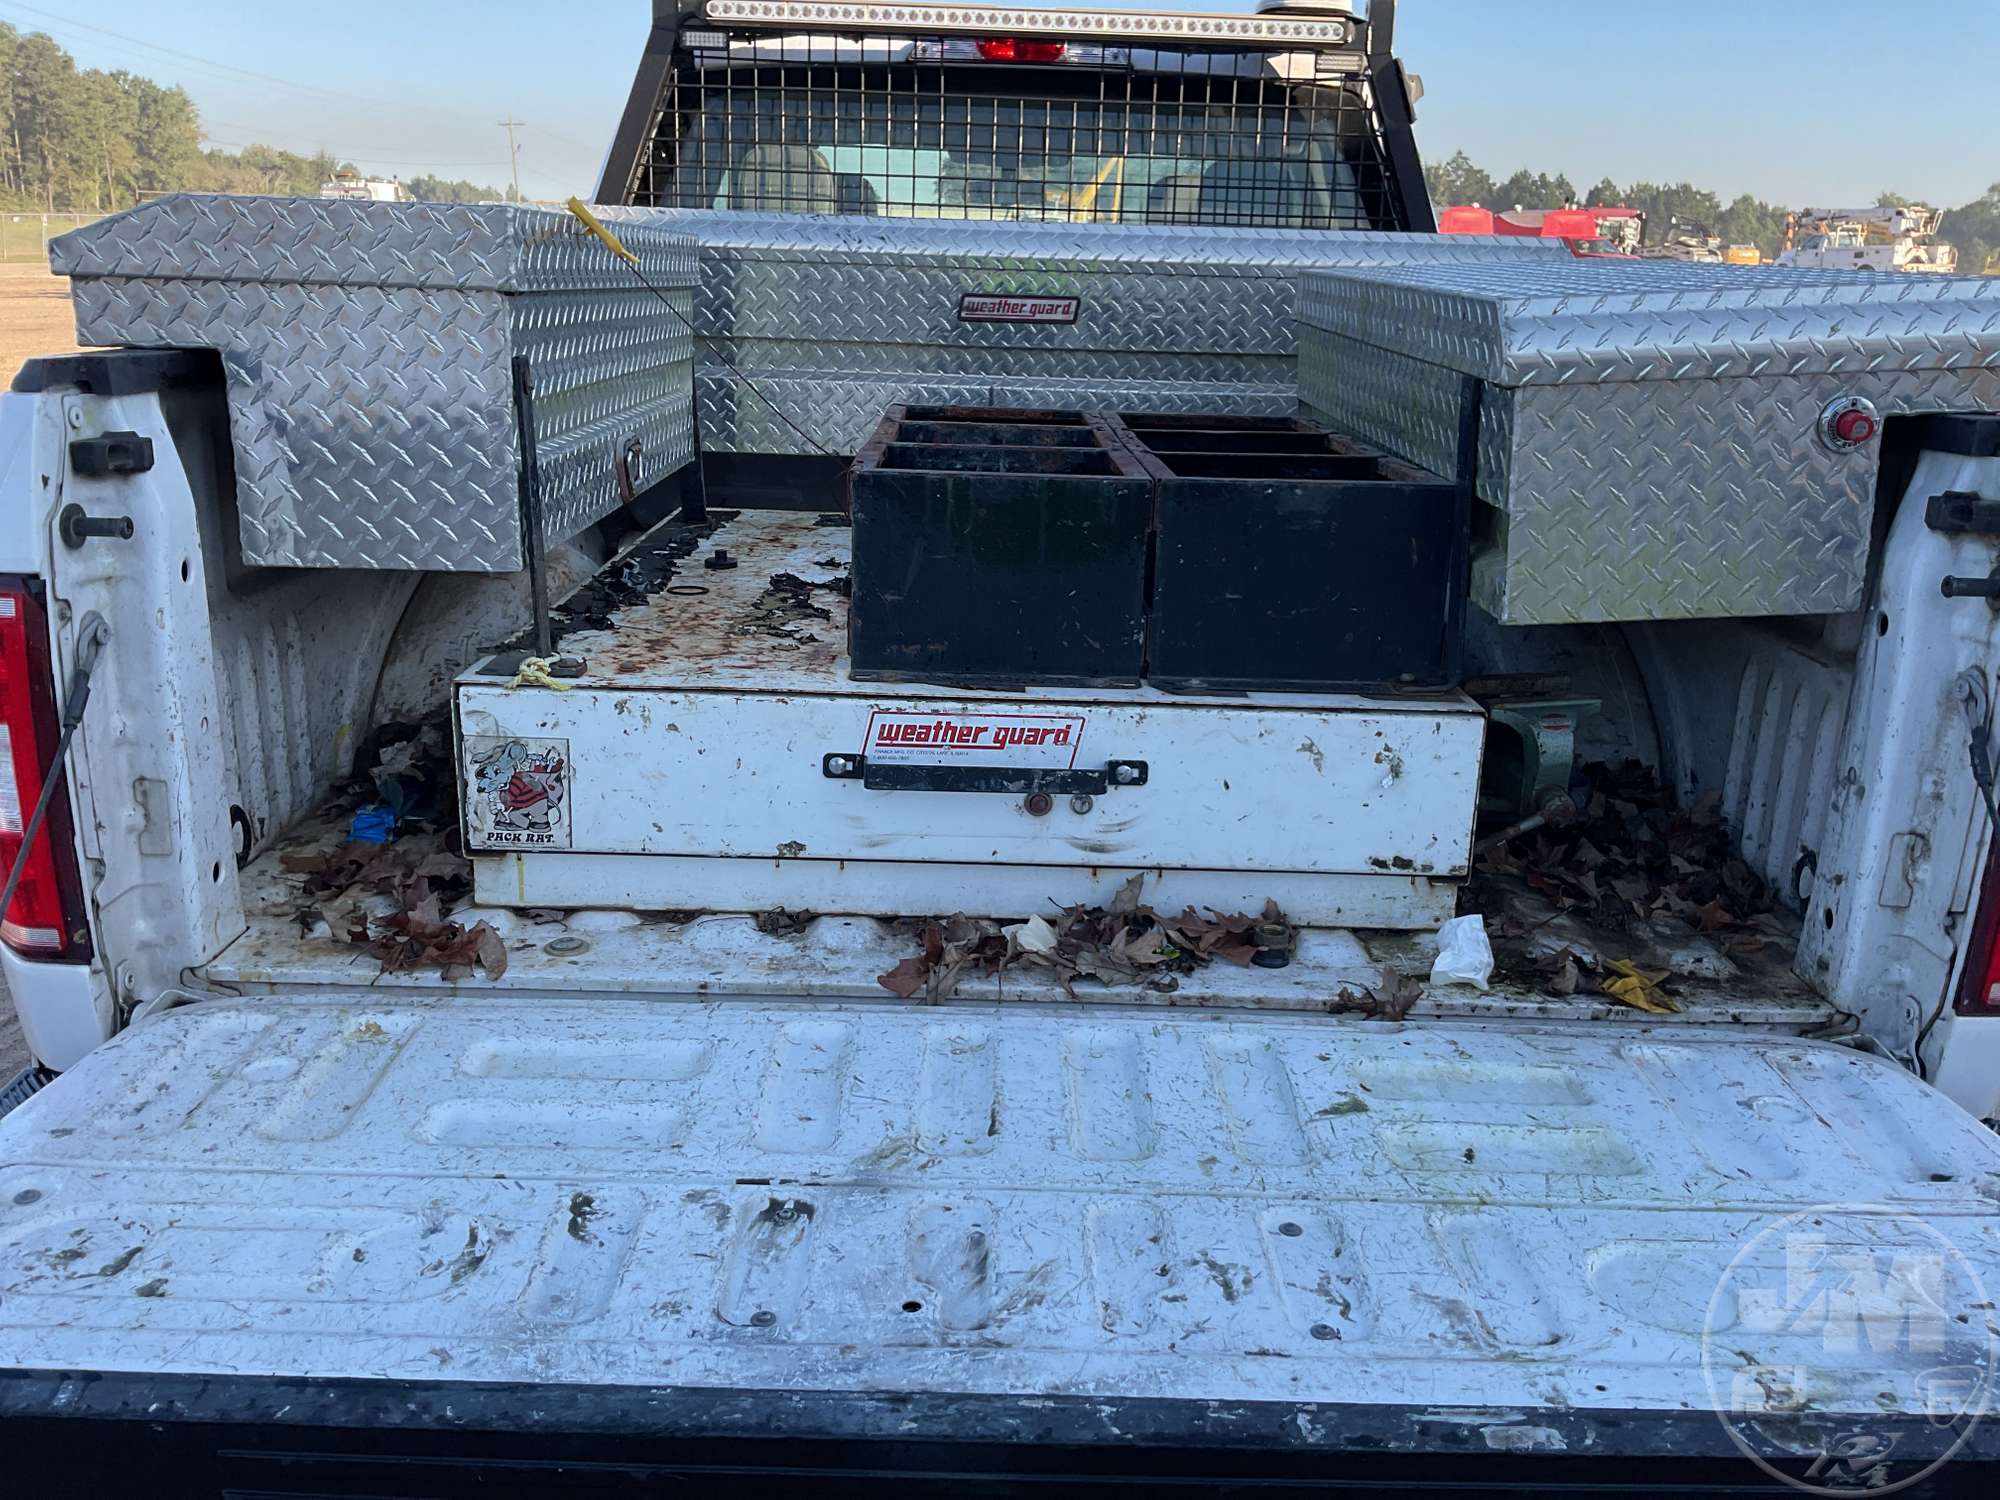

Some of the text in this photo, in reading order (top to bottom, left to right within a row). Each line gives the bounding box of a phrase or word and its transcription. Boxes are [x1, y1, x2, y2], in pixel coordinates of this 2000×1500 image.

[964, 299, 1072, 317] weather guard
[877, 720, 1073, 749] weather guard
[486, 832, 522, 842] PACK
